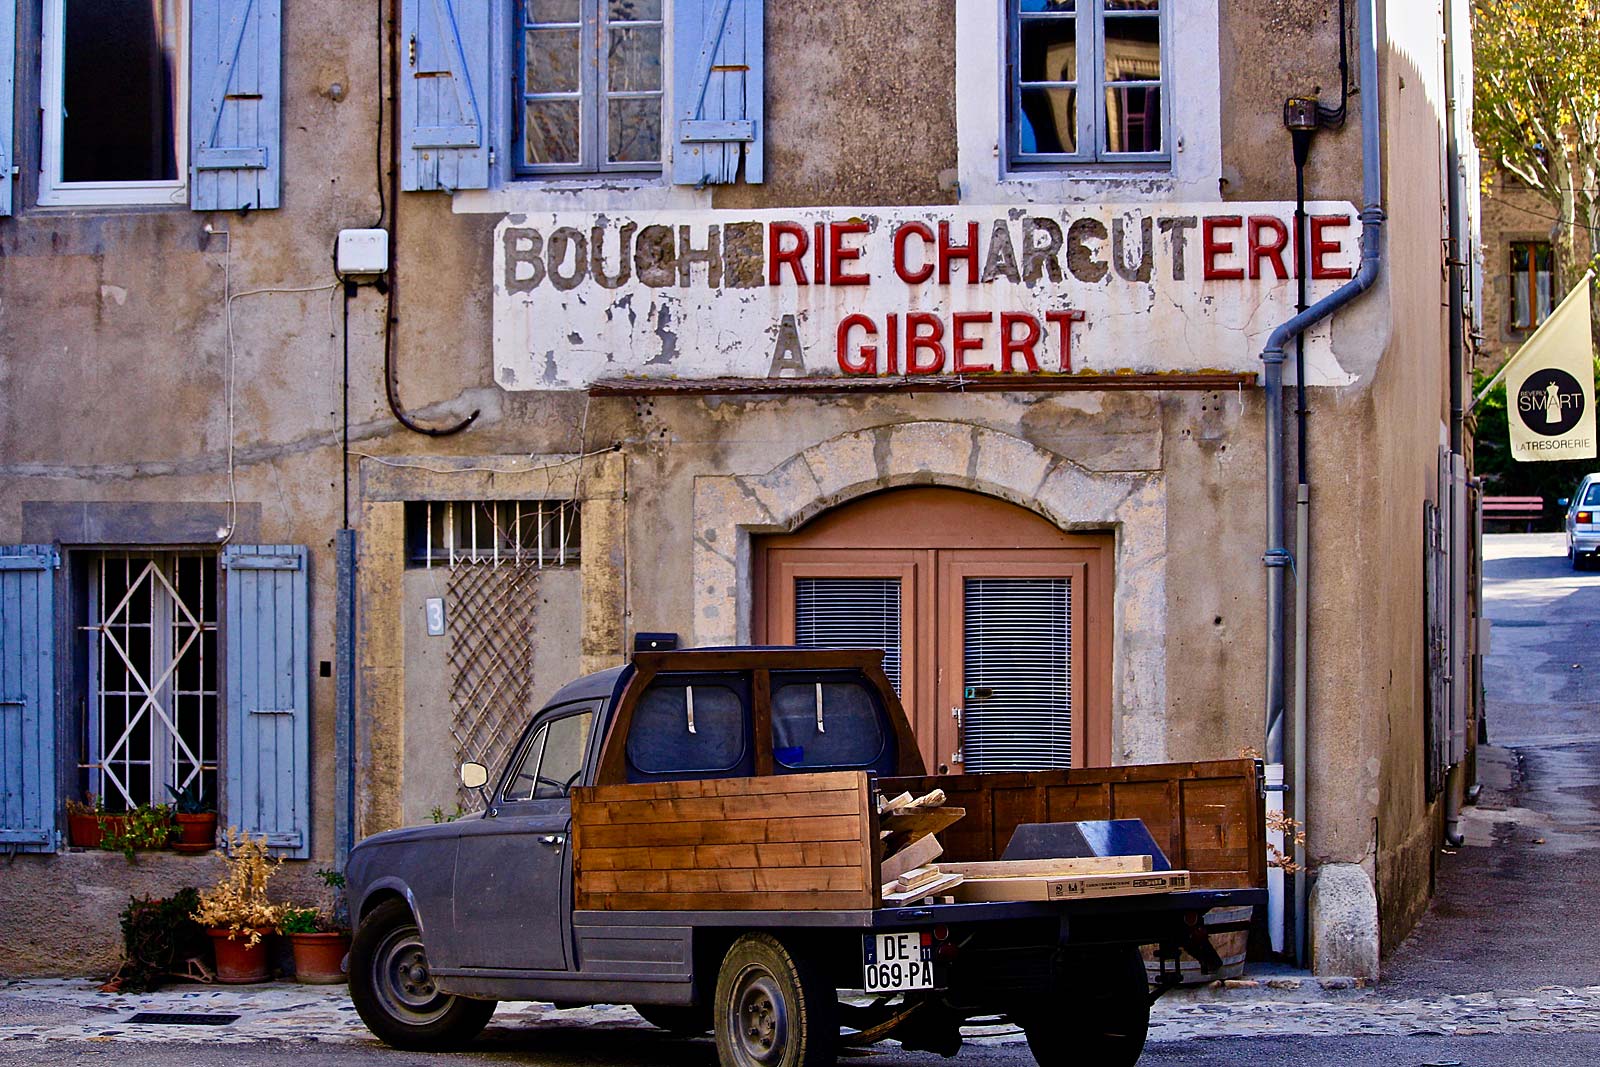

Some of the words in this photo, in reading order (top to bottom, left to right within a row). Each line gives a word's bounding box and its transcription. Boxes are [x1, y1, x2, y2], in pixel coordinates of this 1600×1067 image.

[504, 220, 870, 294] BOUCHRIE
[894, 214, 1351, 287] CHARCUTERIE
[837, 311, 1085, 377] GIBERT
[1519, 393, 1582, 411] SMART
[430, 603, 441, 631] 3
[868, 953, 873, 961] F
[922, 948, 931, 960] 11
[867, 962, 932, 989] 069-PA
